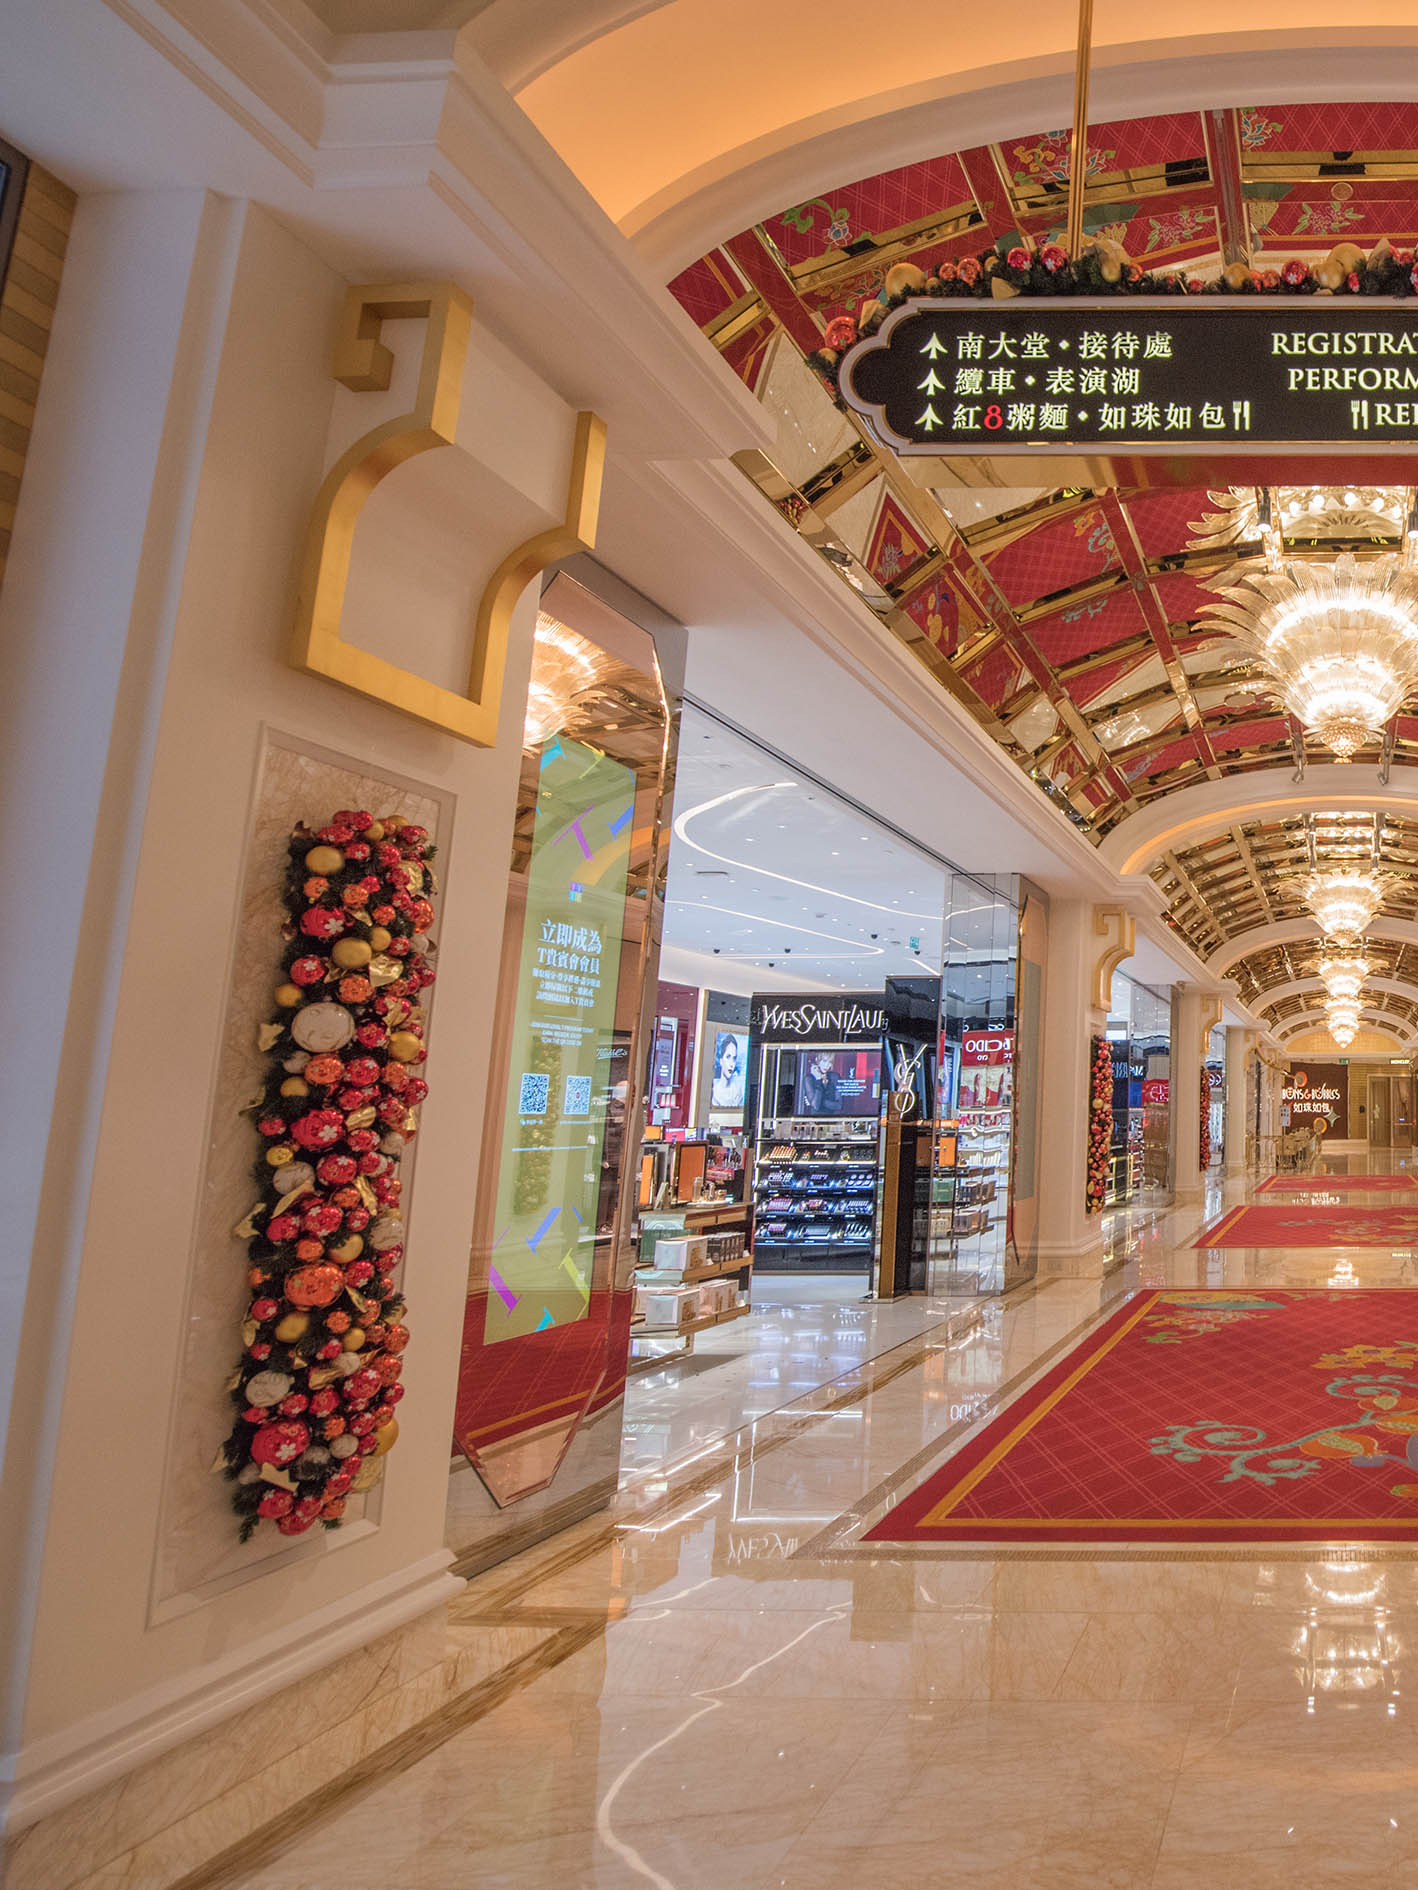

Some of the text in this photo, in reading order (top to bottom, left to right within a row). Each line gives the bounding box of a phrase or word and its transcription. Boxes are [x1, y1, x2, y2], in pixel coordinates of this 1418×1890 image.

[956, 331, 1173, 360] 南大堂 接待處
[953, 366, 1141, 396] 纜車 表演湖
[1097, 402, 1227, 431] 如珠如包
